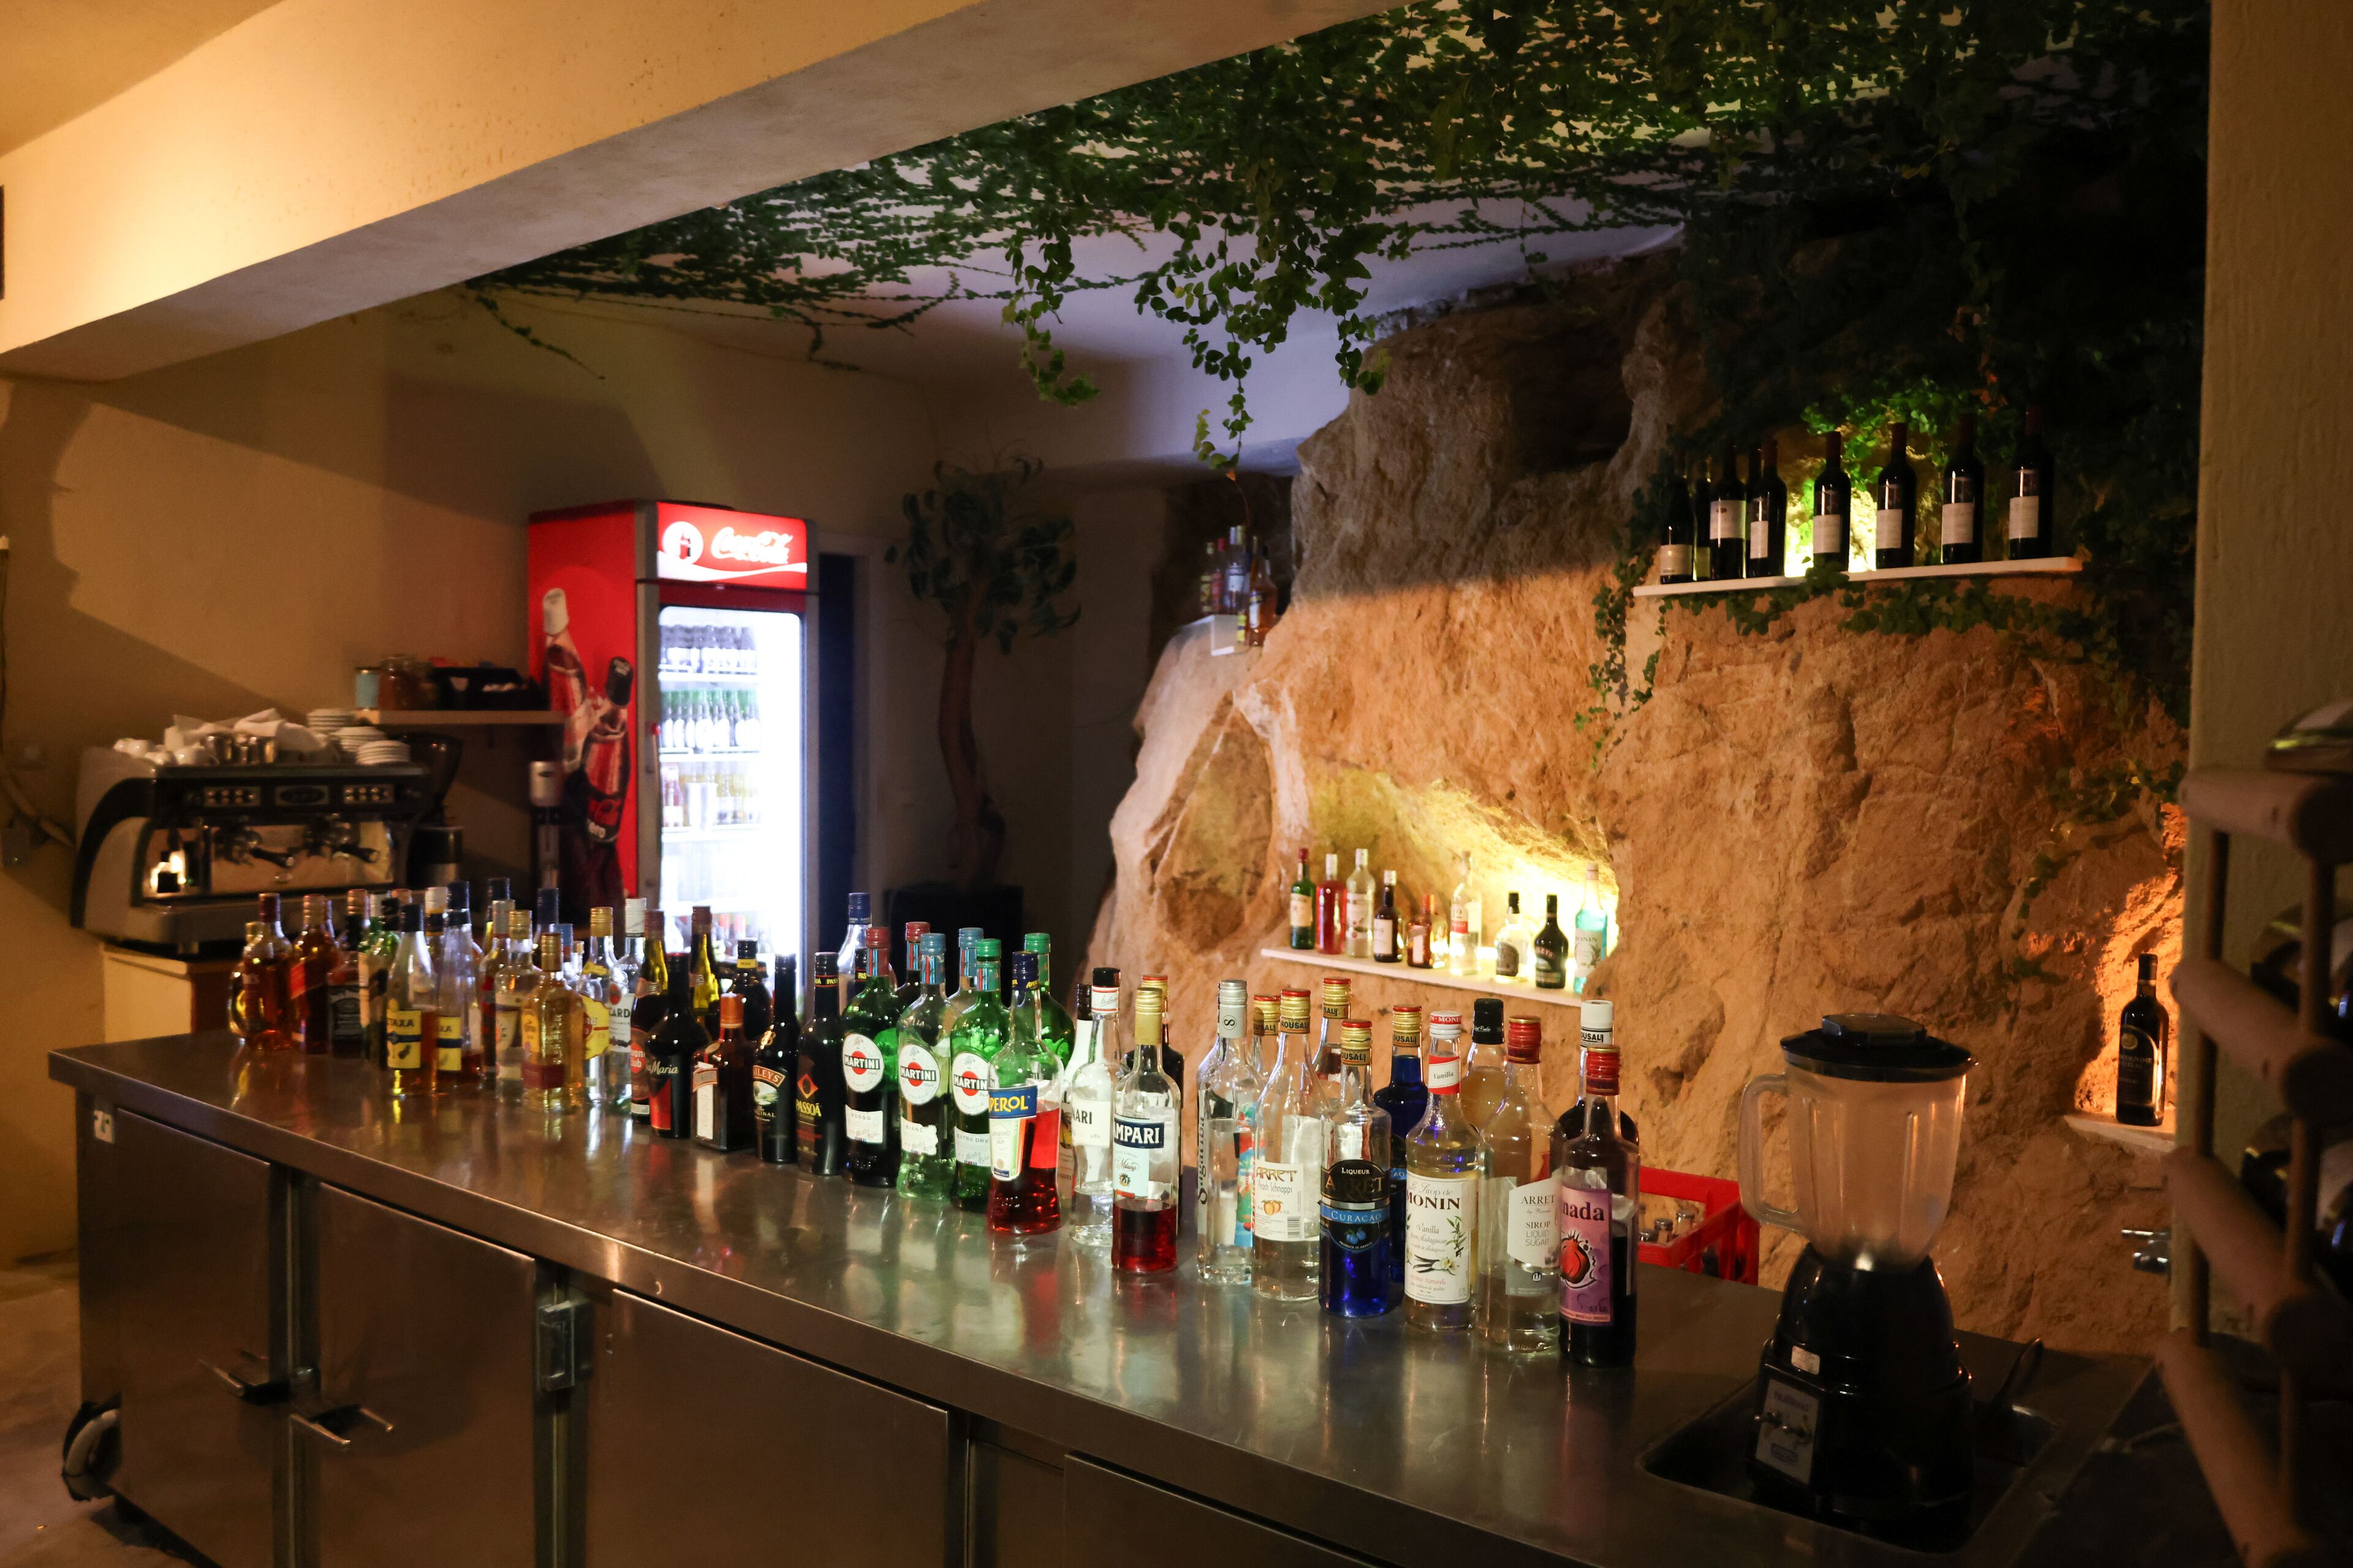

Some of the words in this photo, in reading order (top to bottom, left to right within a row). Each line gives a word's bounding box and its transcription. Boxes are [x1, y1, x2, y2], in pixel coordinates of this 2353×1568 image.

[650, 1060, 679, 1075] Maria
[844, 1055, 879, 1069] MARTINI
[901, 1066, 936, 1081] MARTINI
[1433, 1071, 1454, 1080] Vanilla
[990, 1095, 1029, 1113] PEROL
[957, 1134, 974, 1143] EXTRA
[1256, 1166, 1298, 1182] ARRET
[1258, 1180, 1269, 1191] Peach
[1270, 1183, 1293, 1195] Schnapps
[1407, 1190, 1460, 1210] MONIN
[1331, 1210, 1382, 1222] CURACAO
[1416, 1223, 1440, 1234] Vanilla
[1526, 1221, 1551, 1229] SIROP
[1526, 1230, 1550, 1239] LIQUID
[1525, 1238, 1550, 1246] SUGAR
